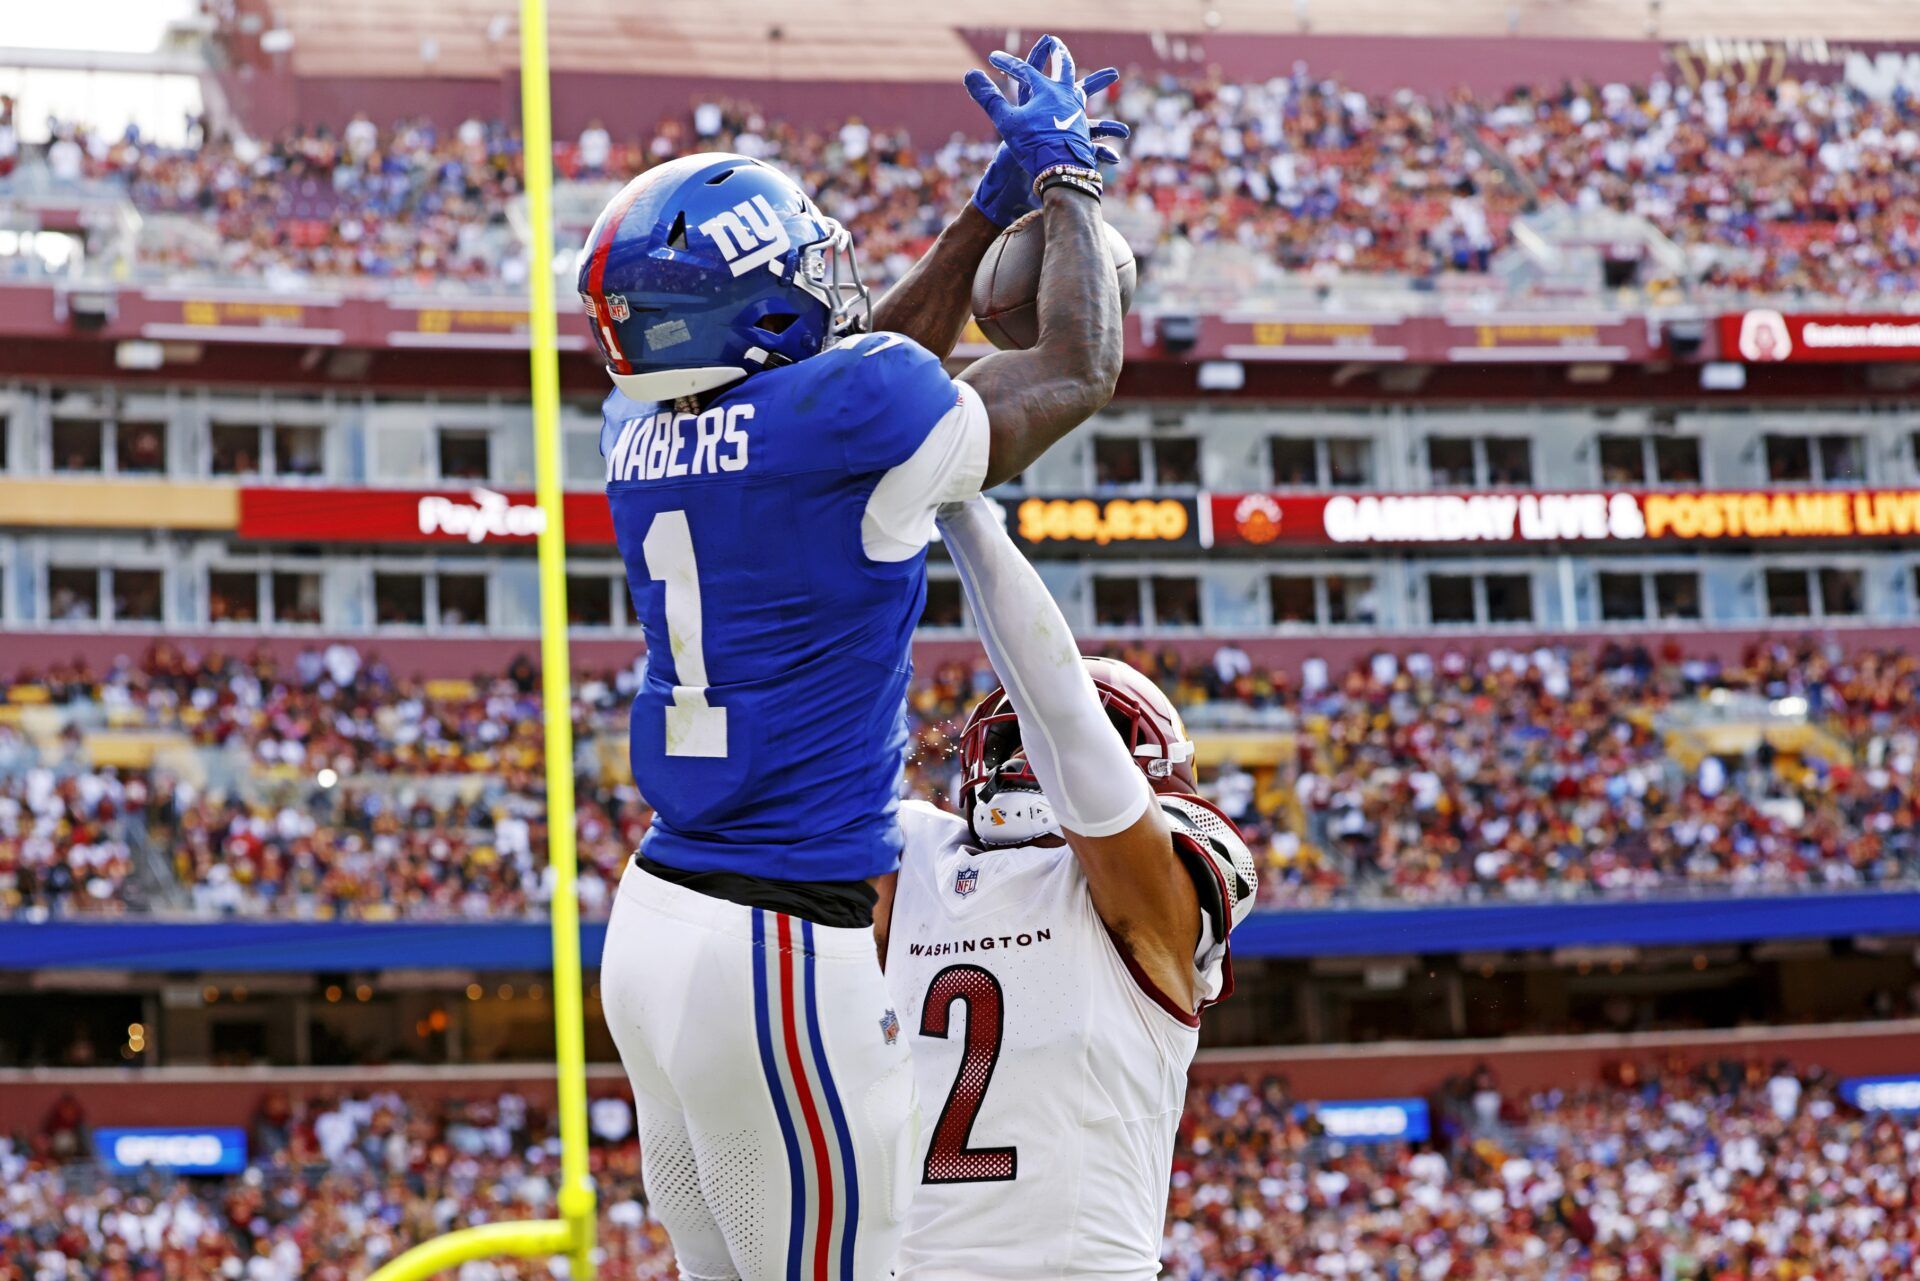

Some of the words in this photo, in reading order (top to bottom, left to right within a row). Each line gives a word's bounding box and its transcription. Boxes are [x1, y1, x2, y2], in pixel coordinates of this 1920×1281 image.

[606, 403, 756, 483] NABERS
[1323, 495, 1518, 542] GAMEDAY
[1519, 494, 1609, 540] LIVE
[1608, 492, 1645, 539] &
[1644, 492, 1851, 538] POSTGAME
[642, 509, 729, 758] 1
[910, 928, 1052, 957] WASHINGTON
[918, 963, 1018, 1185] 2
